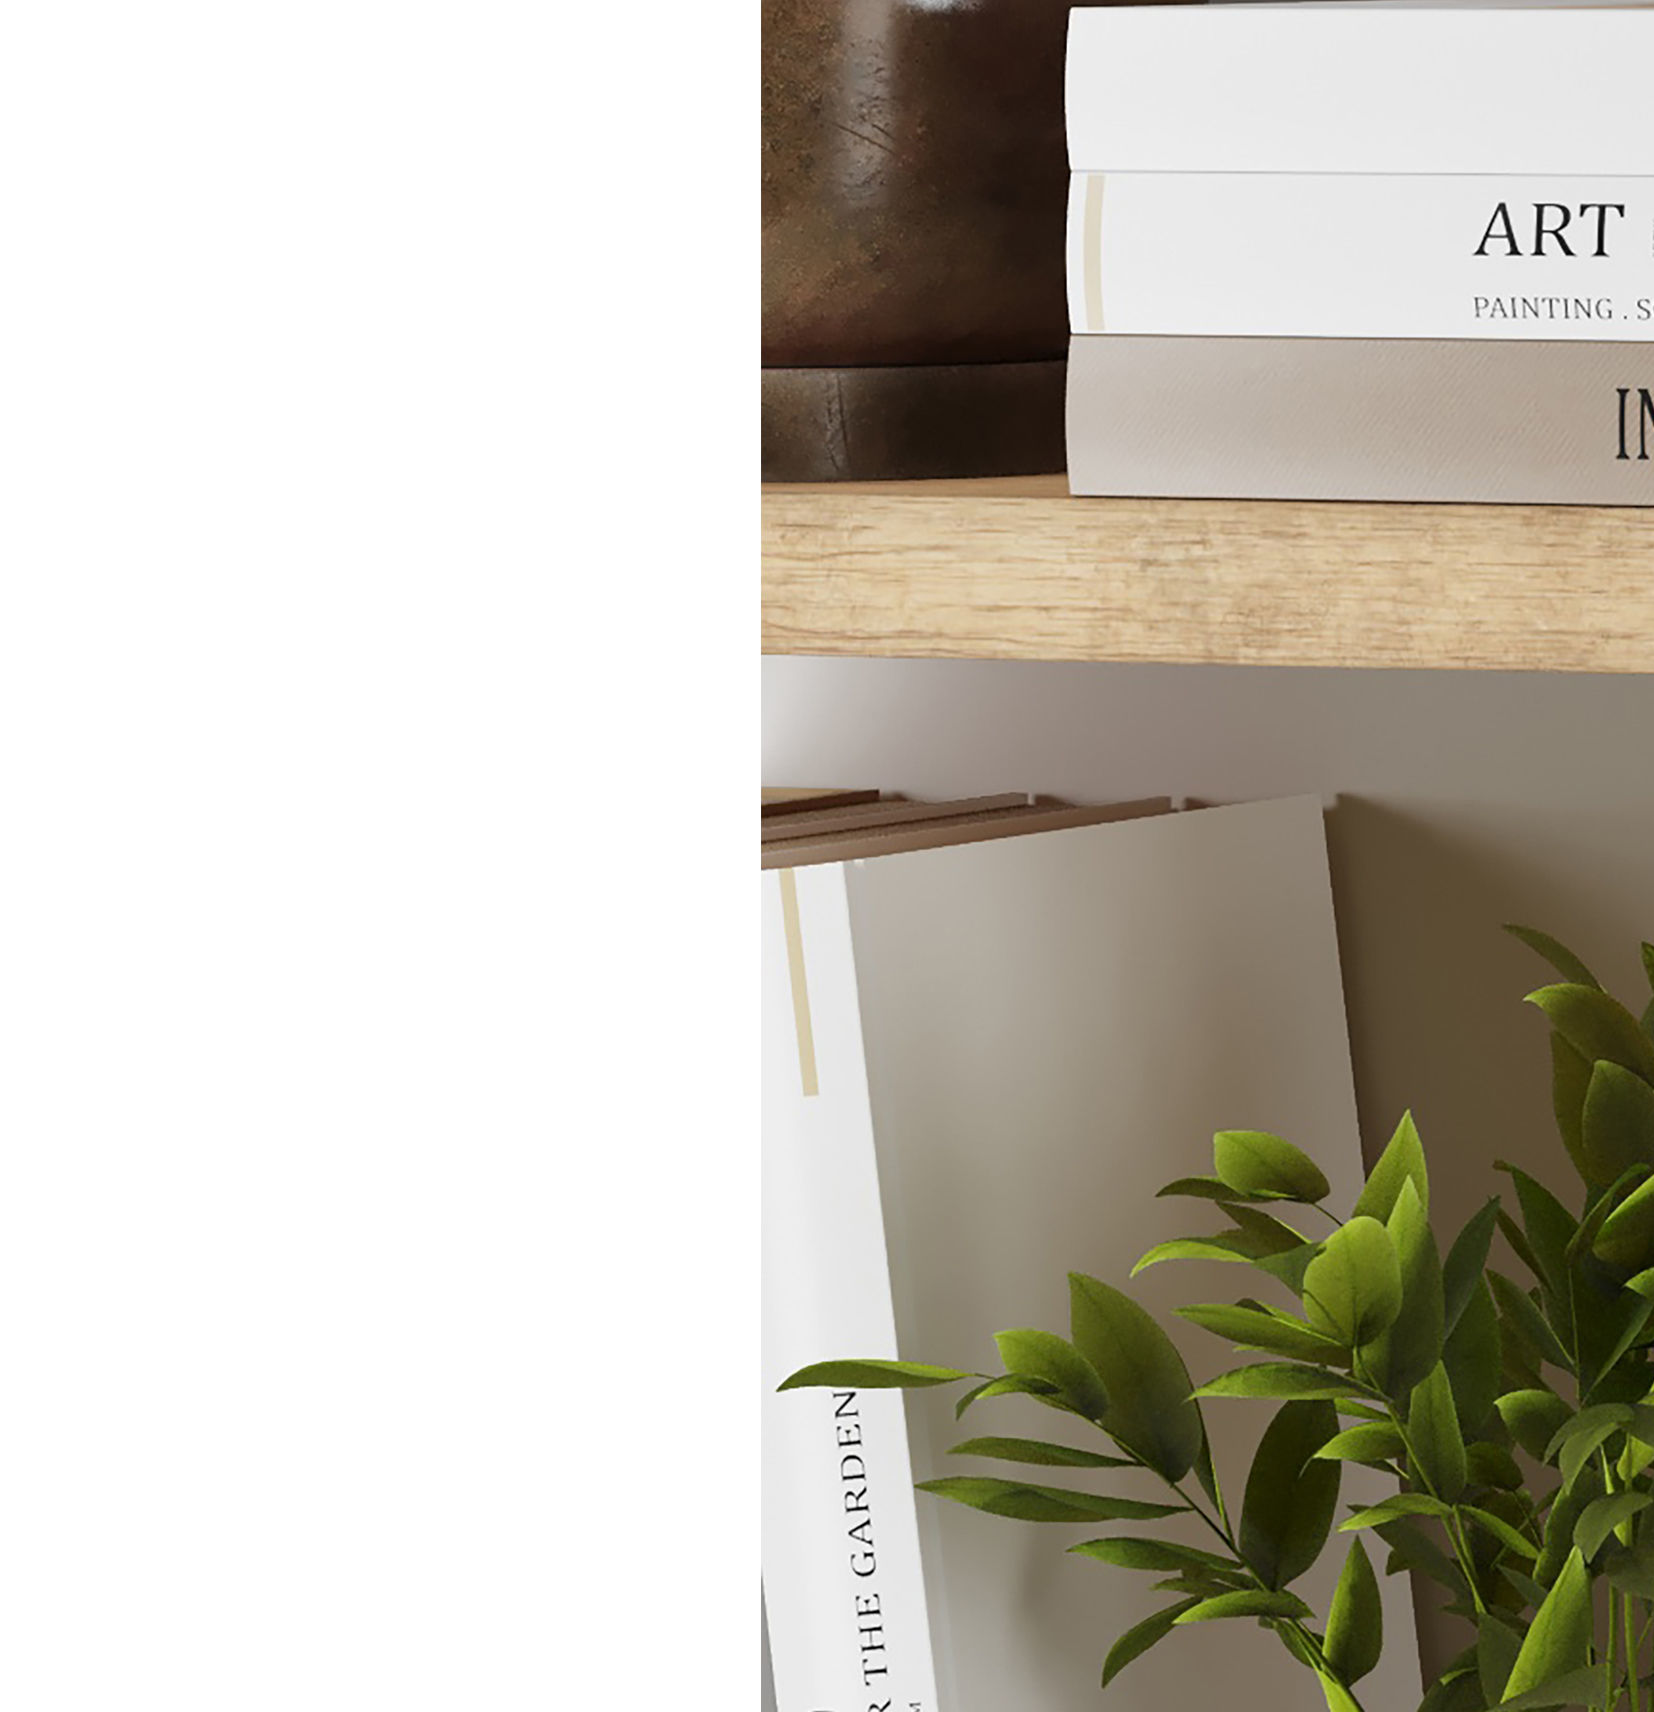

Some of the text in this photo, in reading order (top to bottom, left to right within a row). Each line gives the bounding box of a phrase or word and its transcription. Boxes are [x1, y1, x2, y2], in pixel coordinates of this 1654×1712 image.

[1472, 201, 1626, 258] ART
[1473, 296, 1613, 320] PAINTING
[832, 1391, 877, 1578] GARDEN
[855, 1593, 889, 1687] THE
